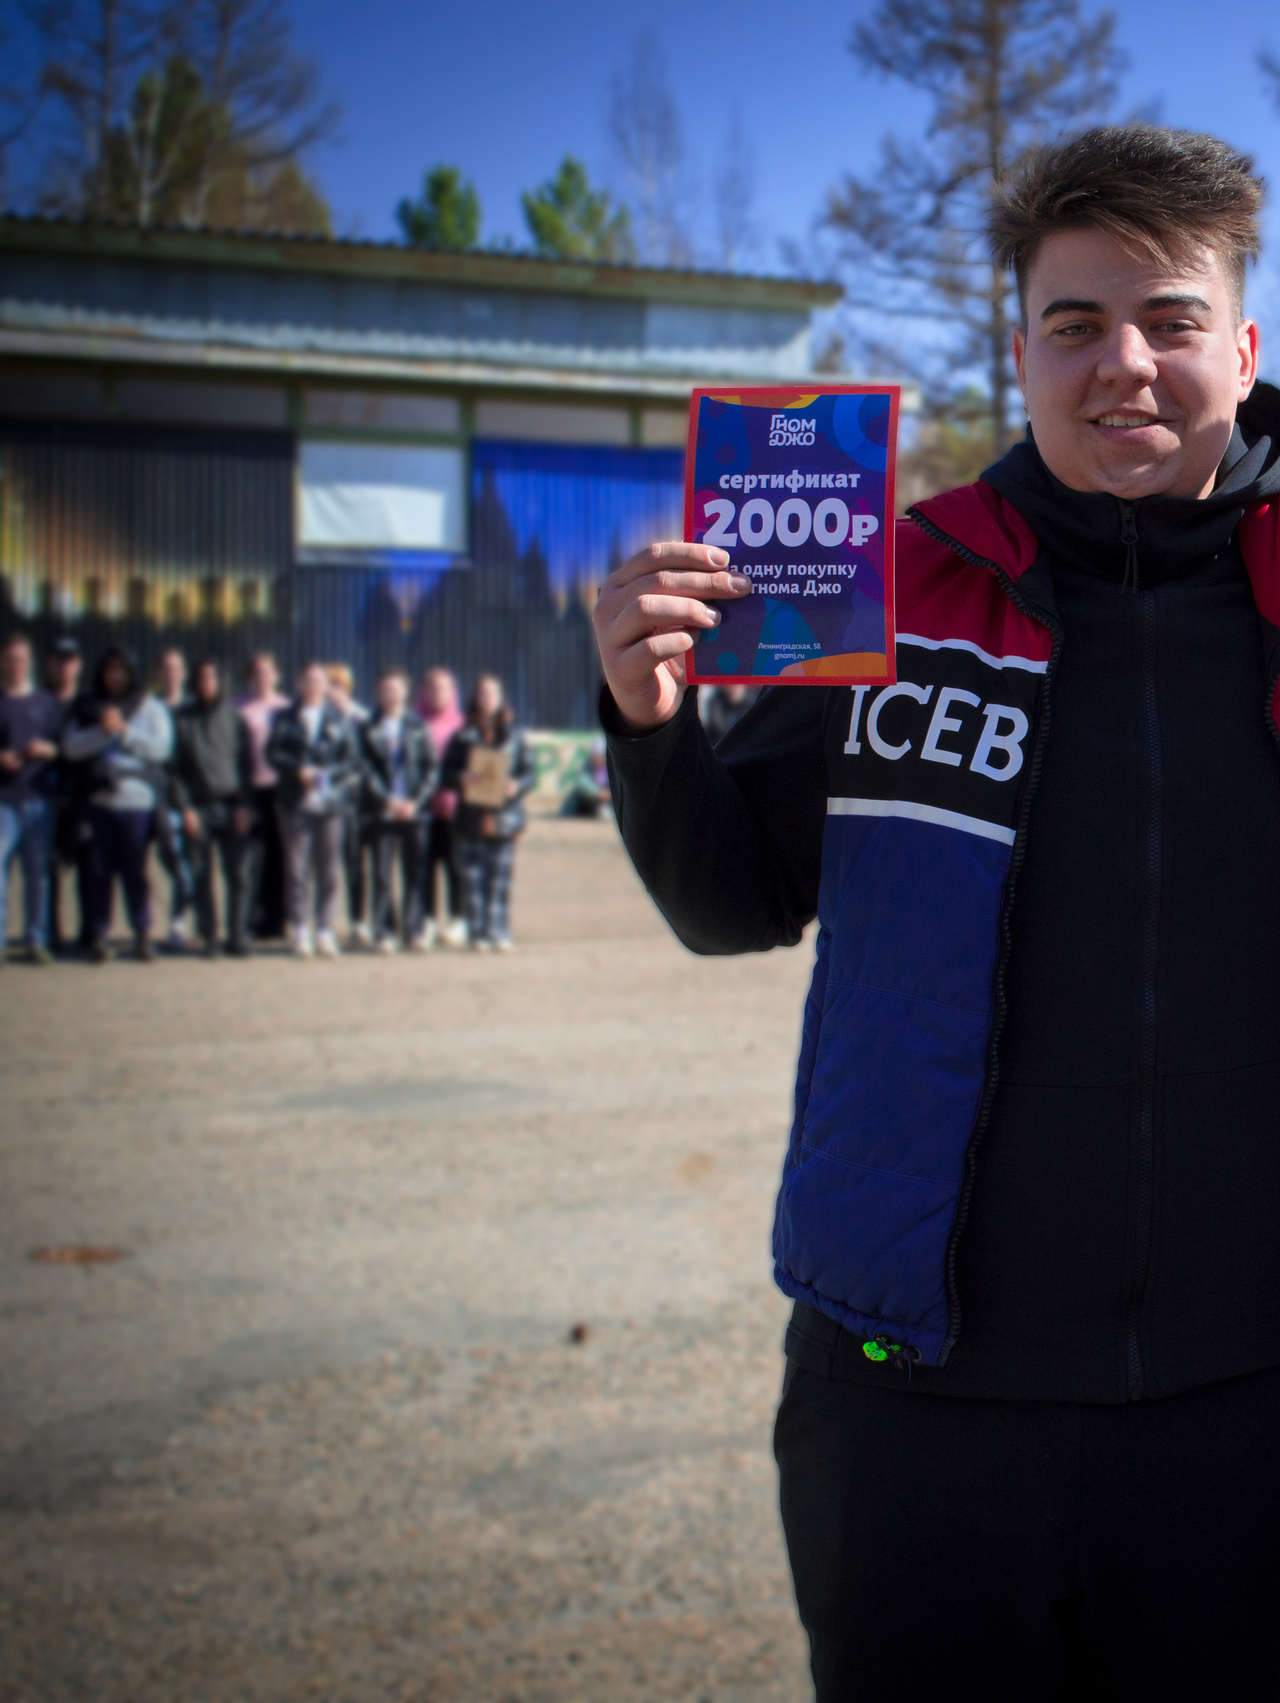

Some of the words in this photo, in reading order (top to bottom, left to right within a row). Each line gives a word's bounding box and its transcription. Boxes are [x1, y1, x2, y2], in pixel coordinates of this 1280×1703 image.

[719, 470, 861, 493] сертификат
[743, 564, 783, 579] одну
[787, 564, 857, 579] покупку
[751, 582, 800, 594] гнома
[803, 580, 842, 596] Джо
[758, 642, 812, 651] Ленинградская,
[774, 652, 805, 660] gnomj.ru
[843, 681, 1029, 782] ICEB
